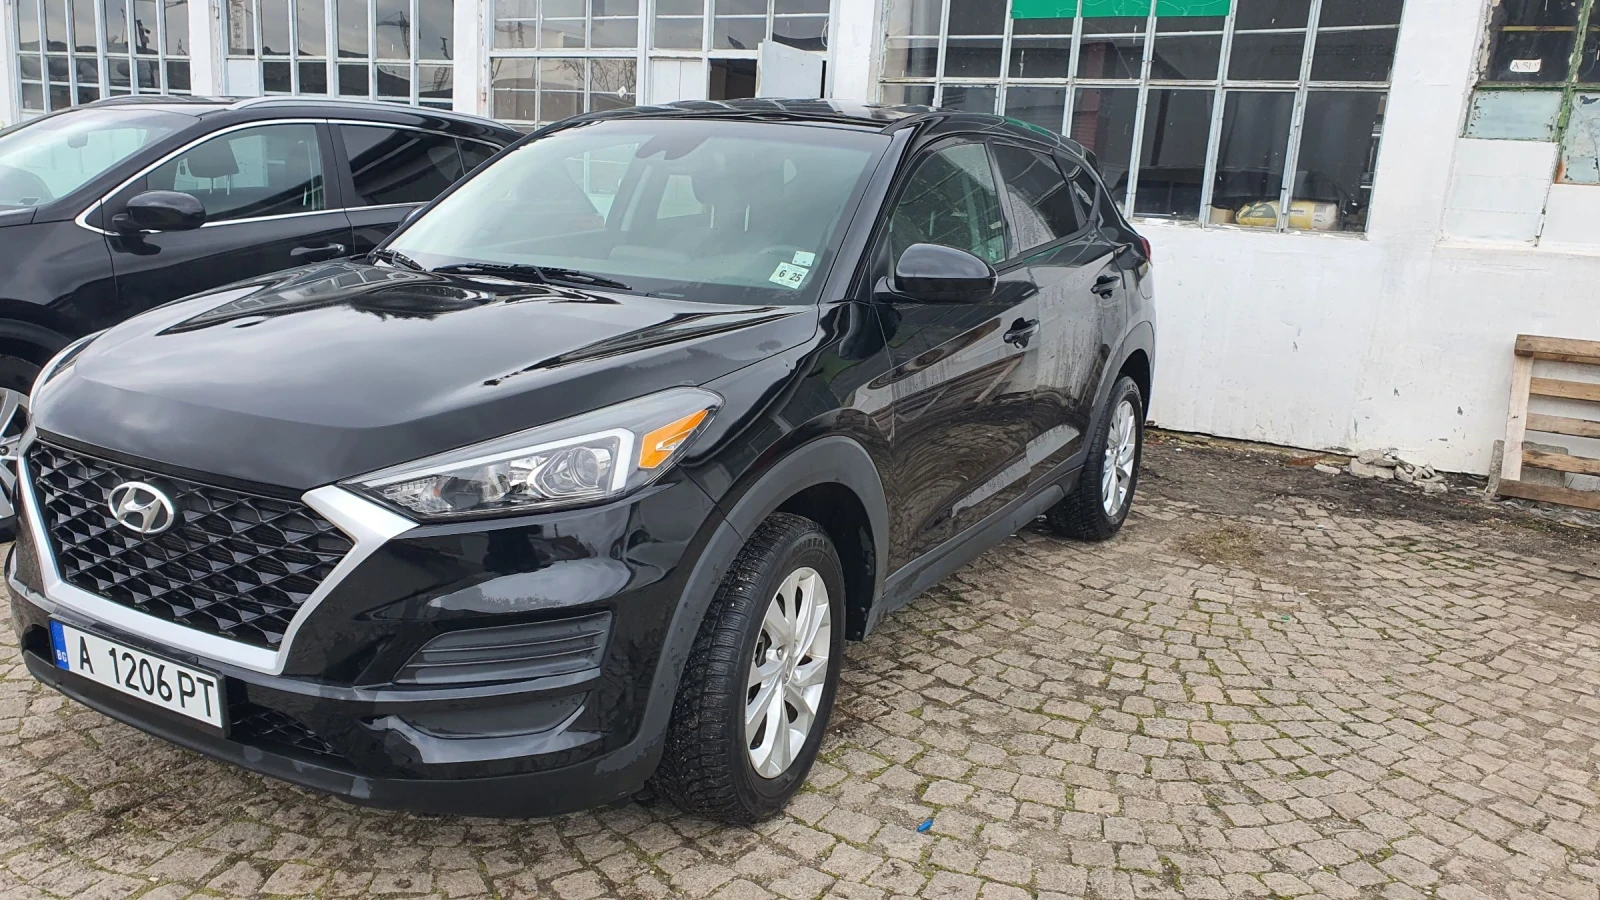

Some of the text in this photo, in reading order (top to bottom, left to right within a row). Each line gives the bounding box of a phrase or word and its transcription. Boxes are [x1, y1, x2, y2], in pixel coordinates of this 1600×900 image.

[778, 269, 803, 282] 6 25
[56, 649, 68, 663] BG
